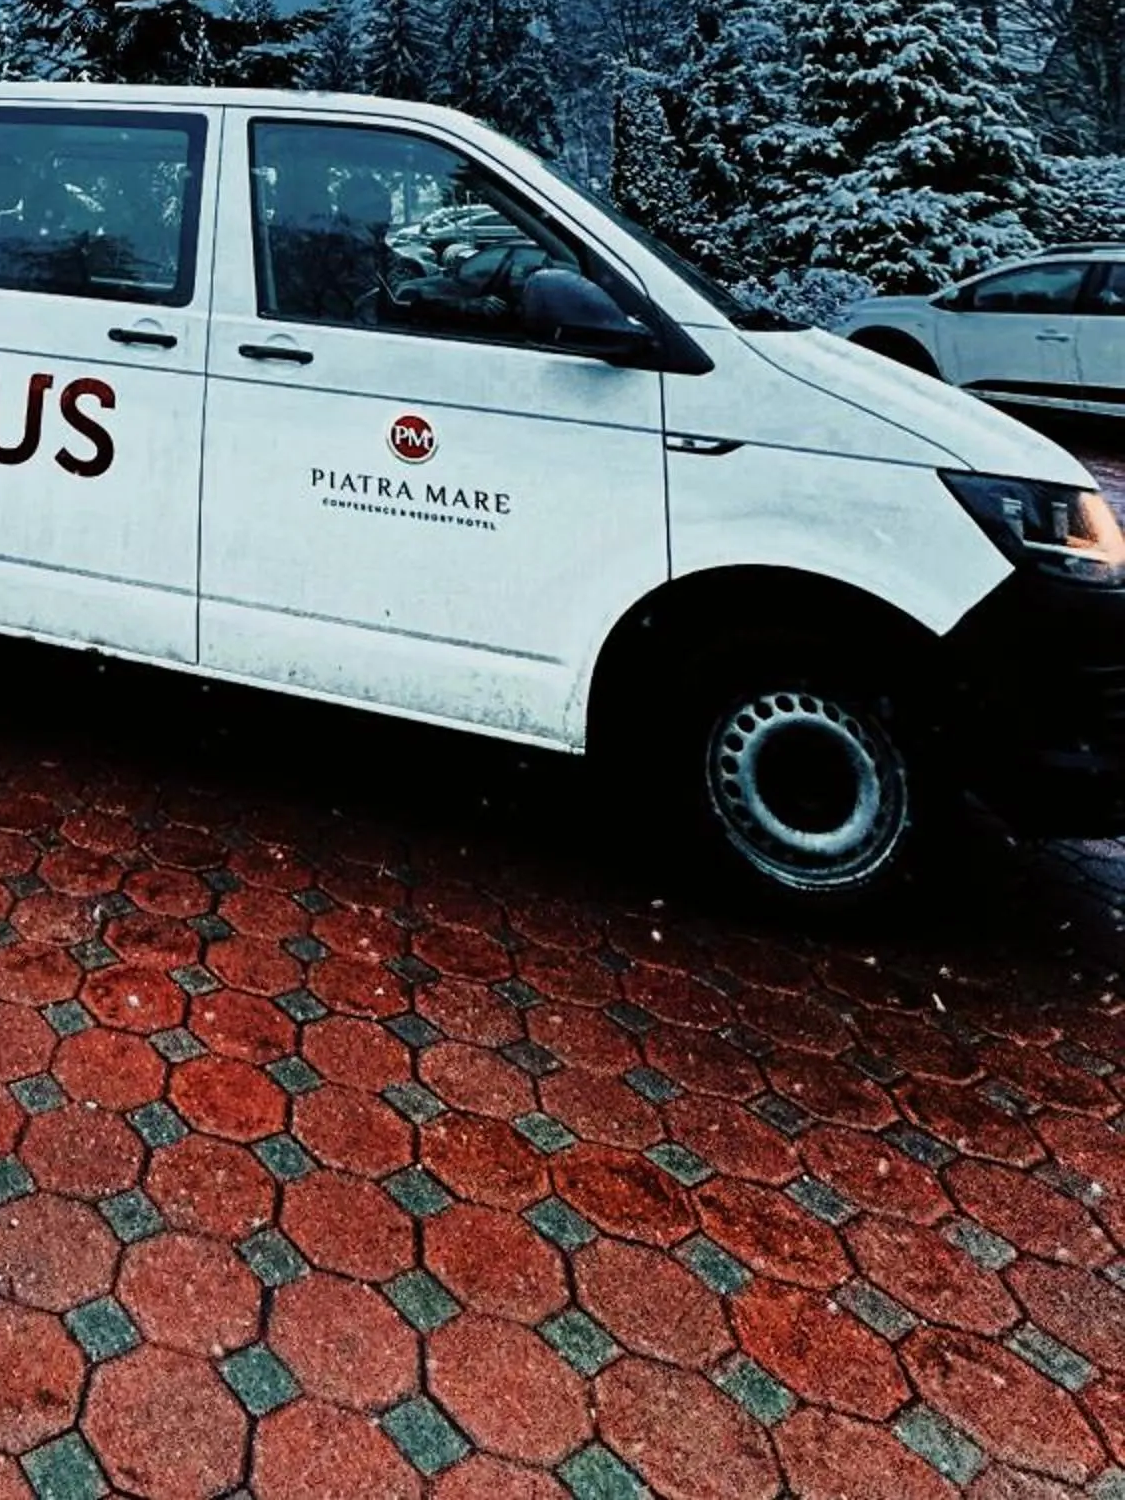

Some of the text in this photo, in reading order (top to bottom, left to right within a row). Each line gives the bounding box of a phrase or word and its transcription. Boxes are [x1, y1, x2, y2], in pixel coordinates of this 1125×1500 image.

[394, 425, 432, 450] PM
[311, 467, 512, 515] PIATRA MARE
[322, 497, 397, 517] CONFERENCE
[456, 516, 497, 531] HOTEL
